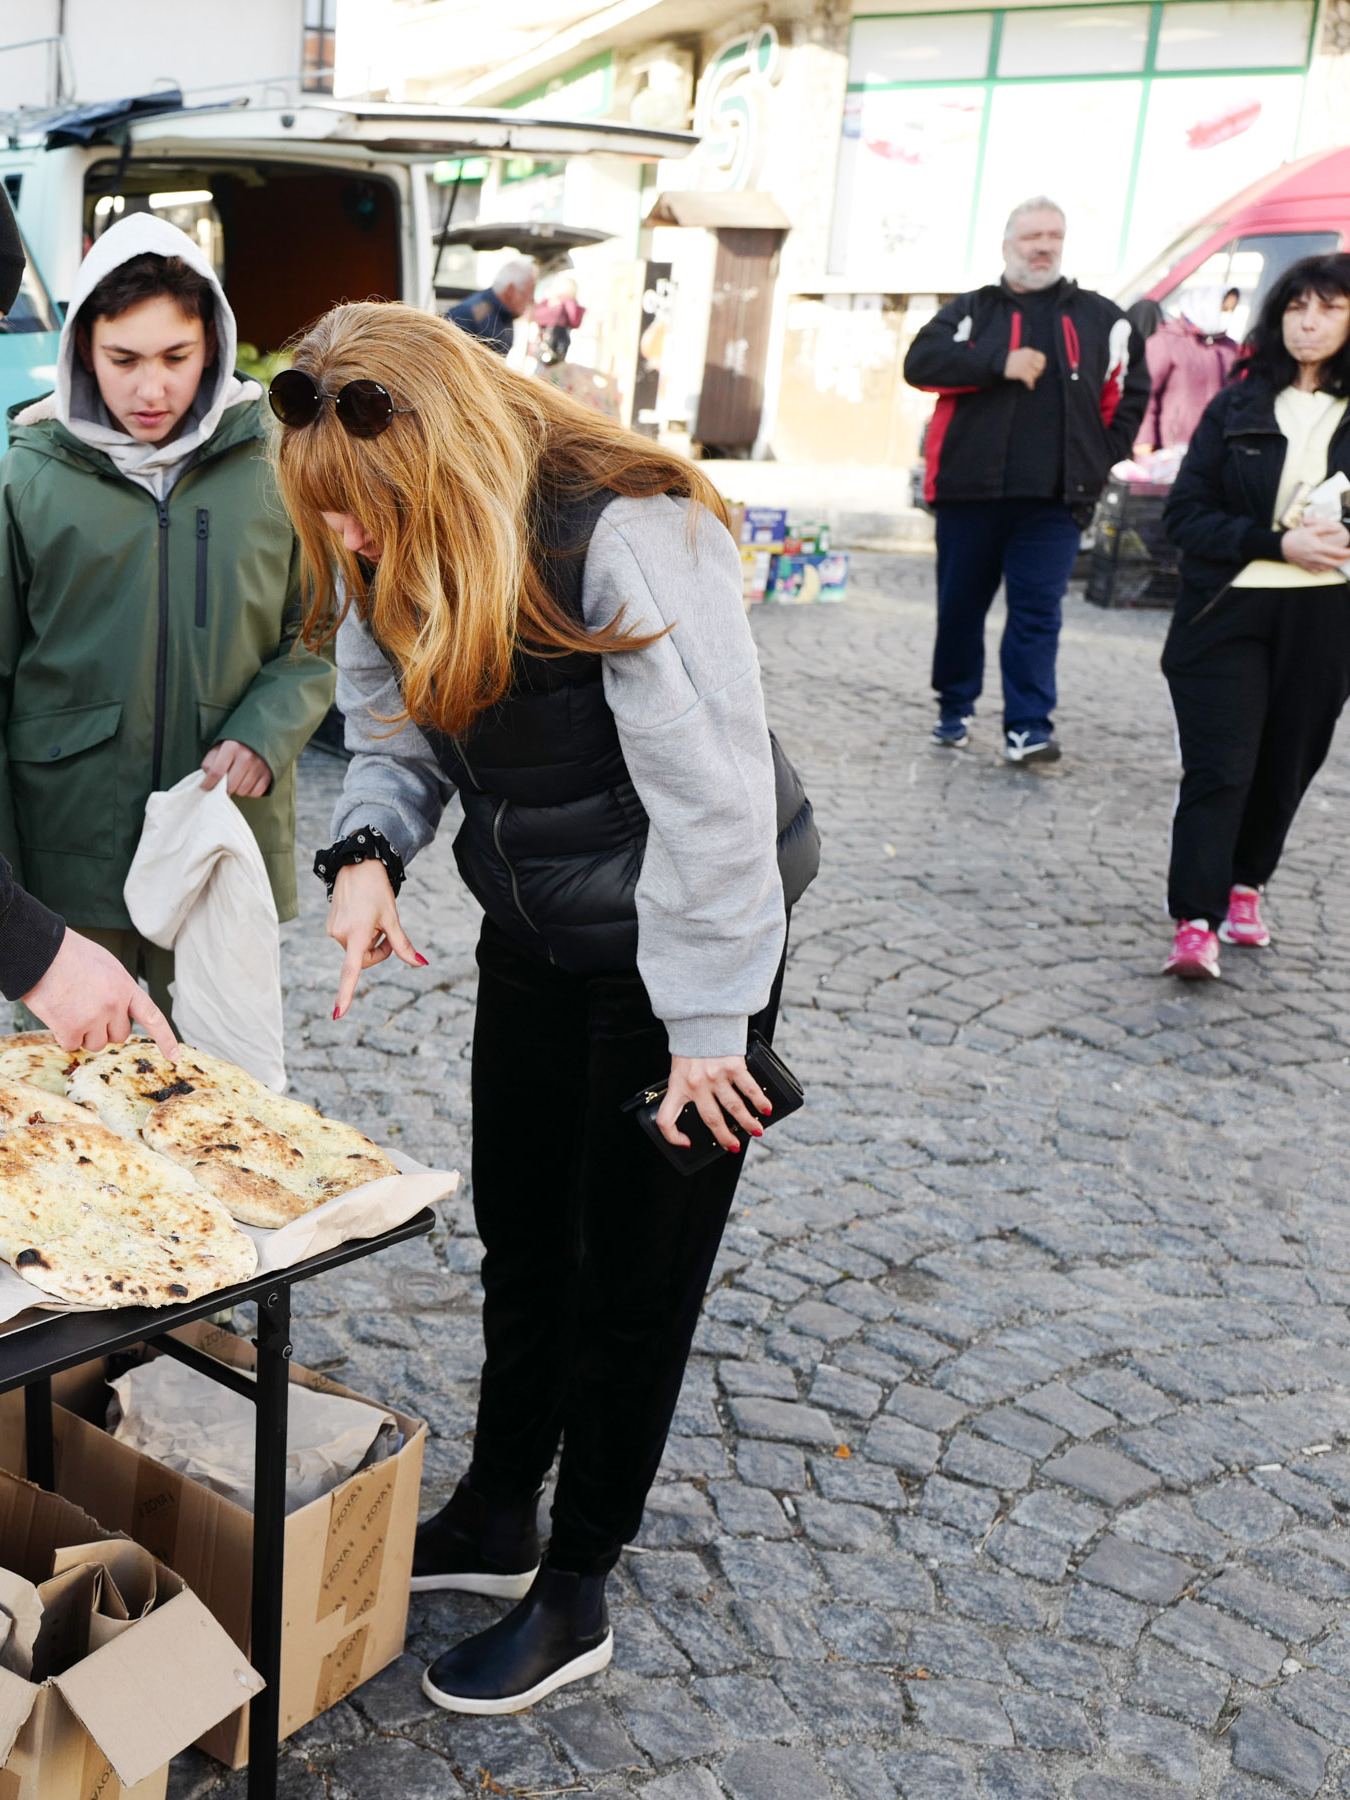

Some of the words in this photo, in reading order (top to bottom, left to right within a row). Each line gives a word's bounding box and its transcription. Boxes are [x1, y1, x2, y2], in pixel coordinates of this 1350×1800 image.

[336, 1493, 358, 1527] ZOYA
[365, 1490, 388, 1523] ZOYA
[327, 1548, 350, 1582] ZOYA
[356, 1545, 378, 1577] ZOYA
